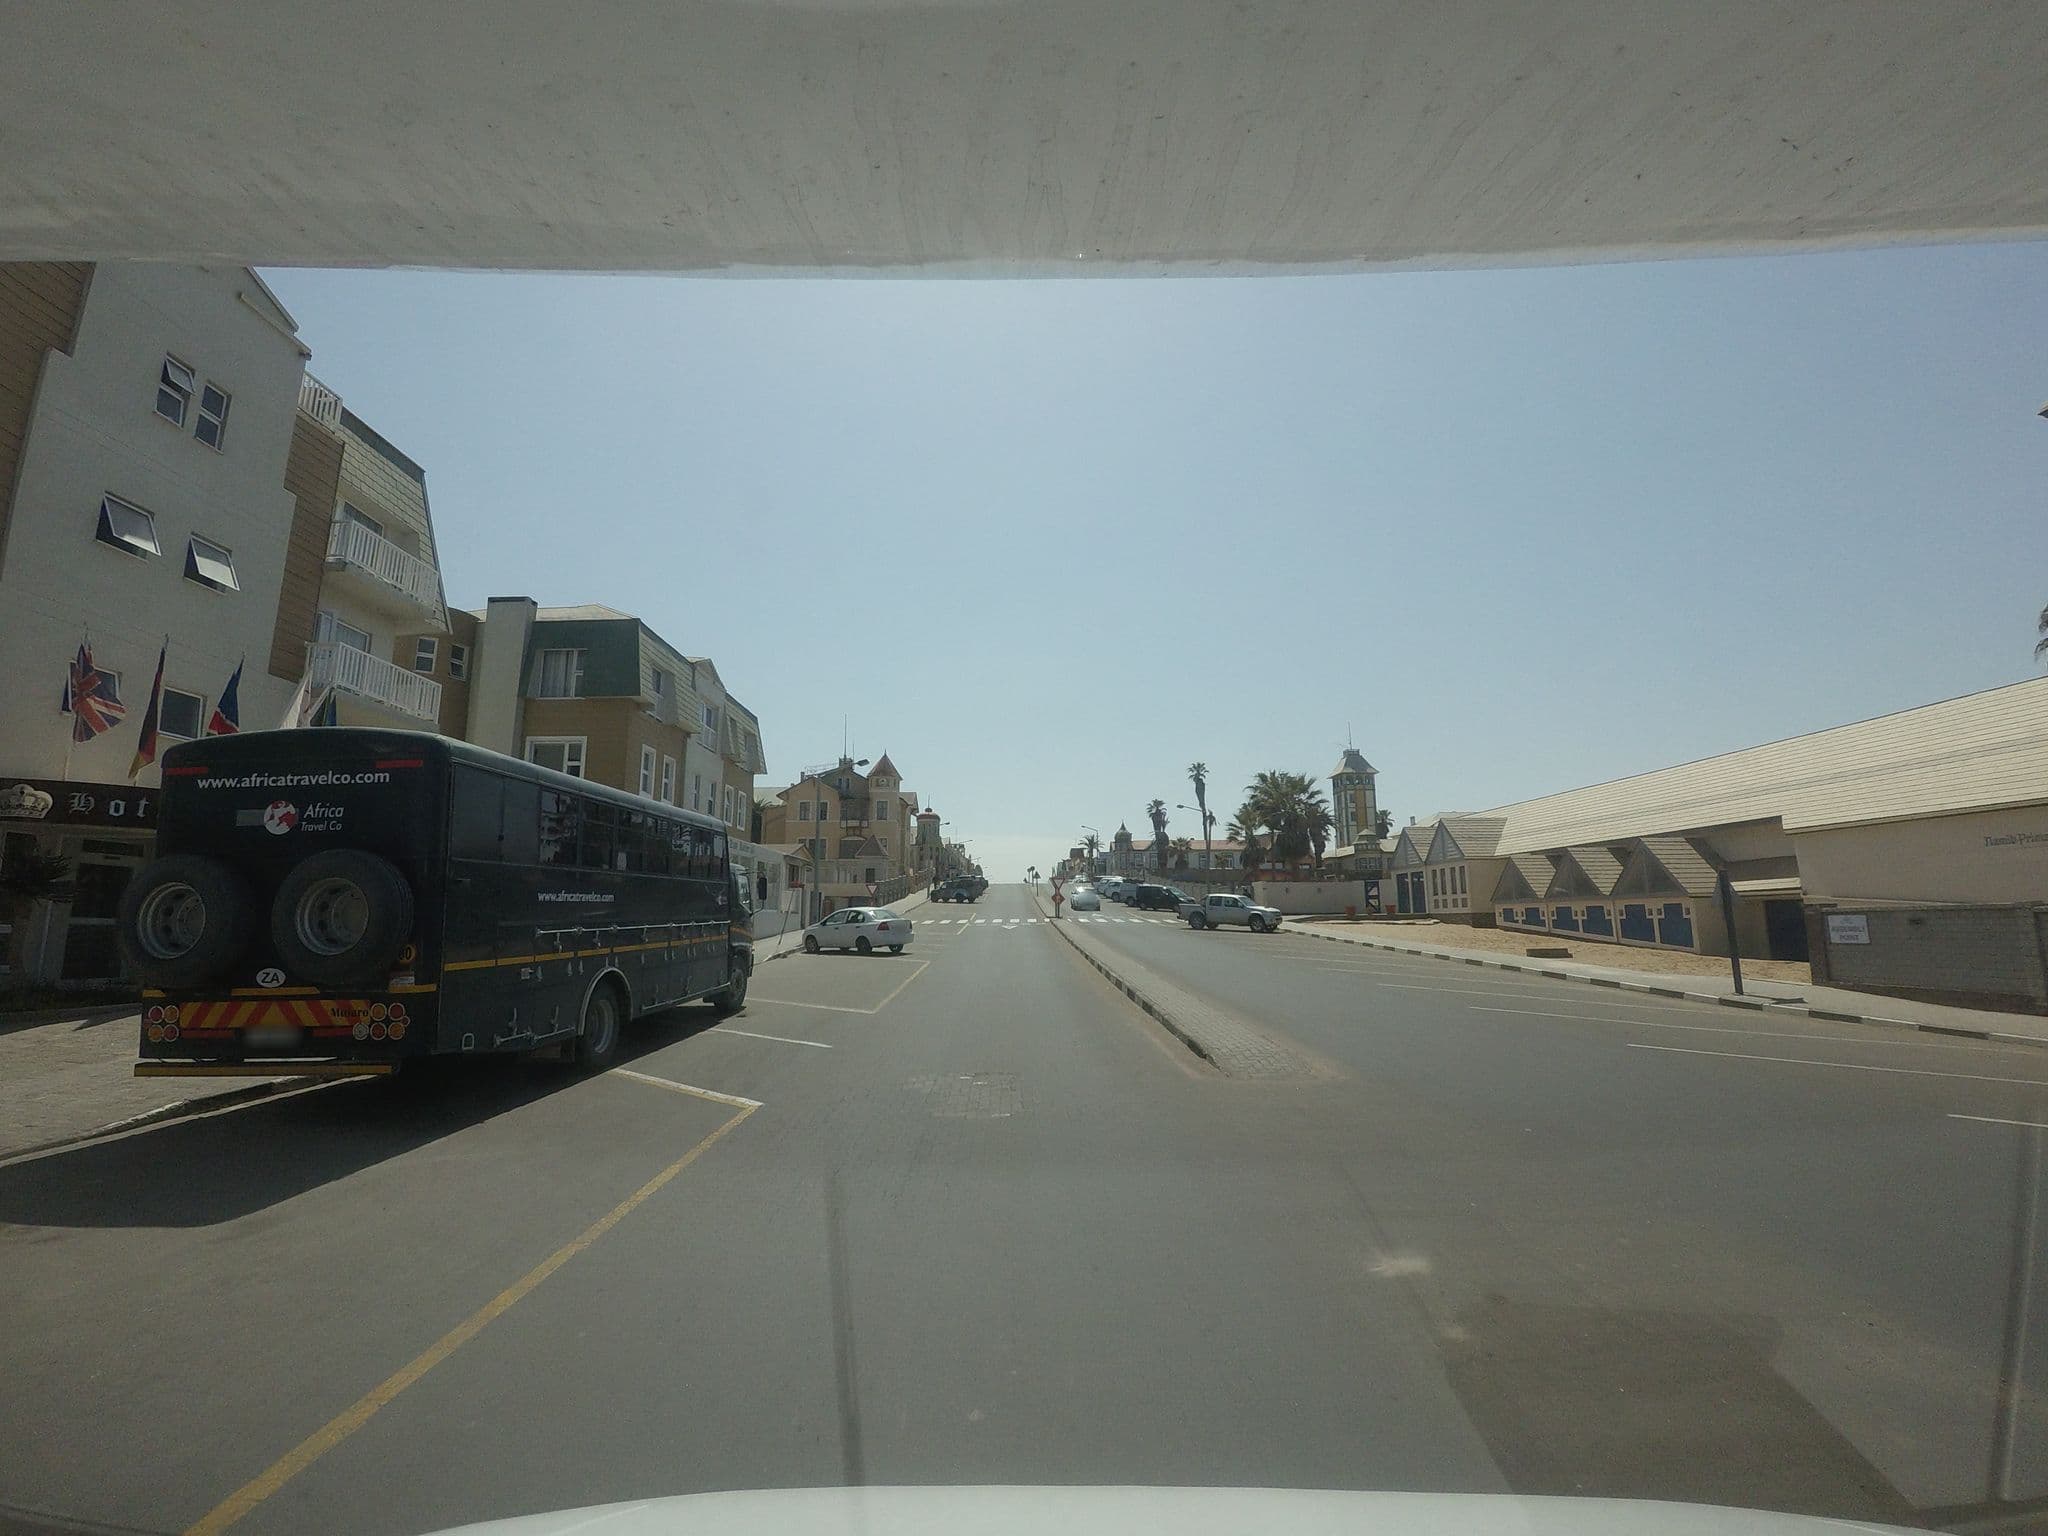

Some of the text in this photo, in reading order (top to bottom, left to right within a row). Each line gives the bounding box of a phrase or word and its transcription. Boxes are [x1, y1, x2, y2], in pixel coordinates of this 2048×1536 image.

[197, 770, 390, 789] www.africatravelco.com
[303, 802, 344, 820] Africa
[301, 820, 342, 832] Travel Co
[261, 971, 280, 984] ZA
